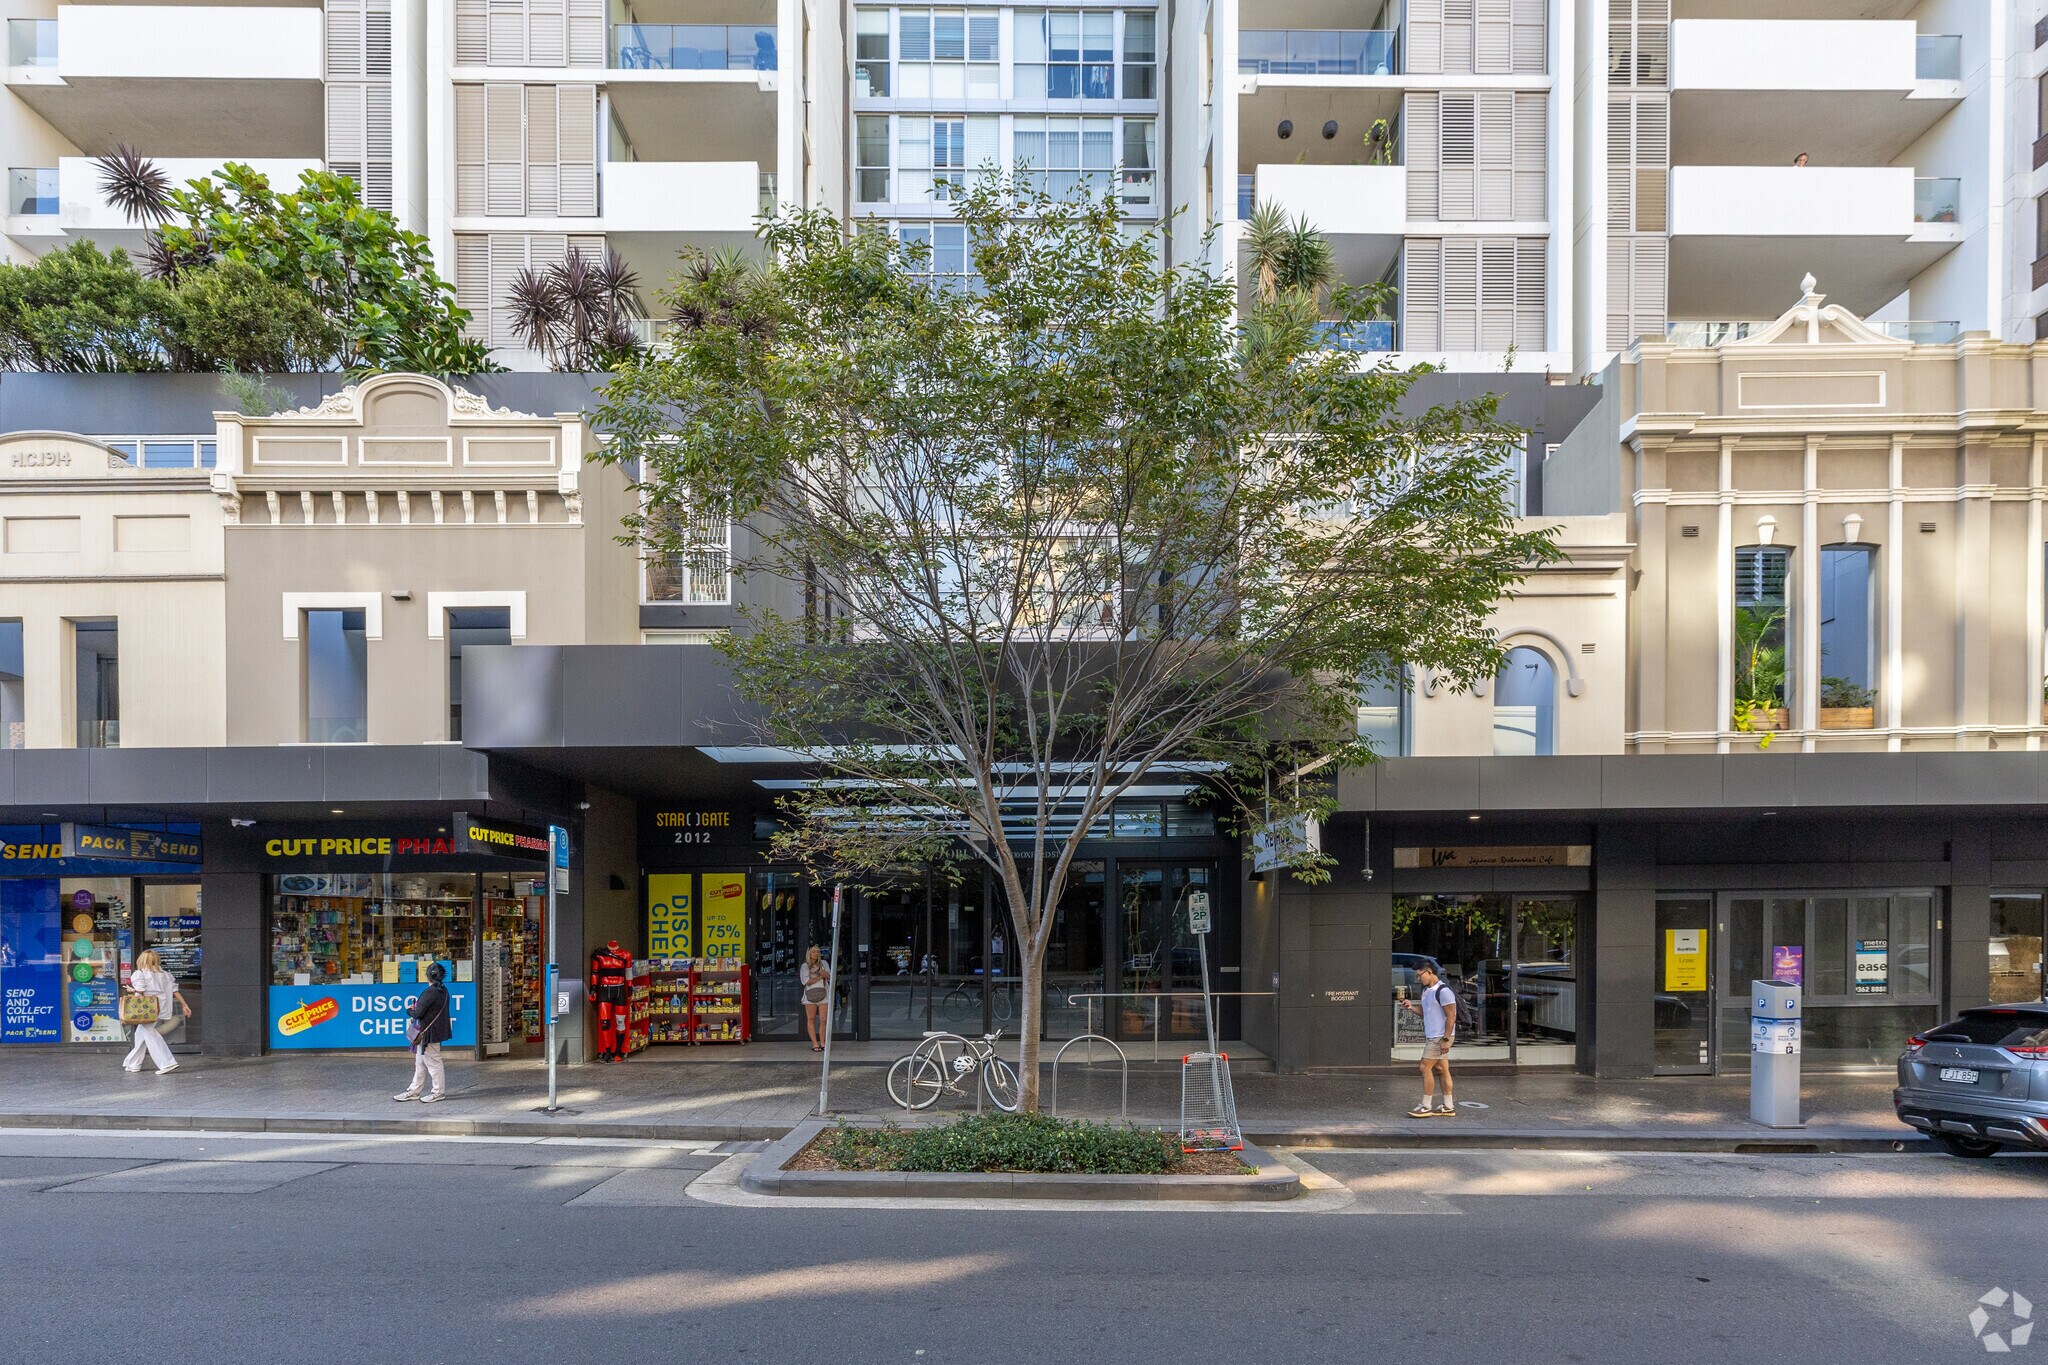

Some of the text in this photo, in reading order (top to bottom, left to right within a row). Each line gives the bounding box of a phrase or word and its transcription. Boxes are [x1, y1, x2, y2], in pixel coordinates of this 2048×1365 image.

[469, 826, 490, 843] CUT
[489, 830, 514, 846] PRICE
[675, 832, 711, 843] 2012
[3, 844, 62, 859] SEND
[81, 835, 198, 856] PACK SEND
[265, 838, 317, 856] CUT
[321, 838, 391, 855] PRICE
[1193, 911, 1206, 920] 2P
[706, 924, 741, 938] 75%
[706, 943, 741, 957] OFF
[6, 989, 35, 998] SEND
[6, 999, 30, 1007] AND
[1786, 1000, 1793, 1008] P
[7, 1006, 53, 1015] COLLECT
[285, 1000, 335, 1026] CUT PRICE
[7, 1015, 35, 1024] WITH
